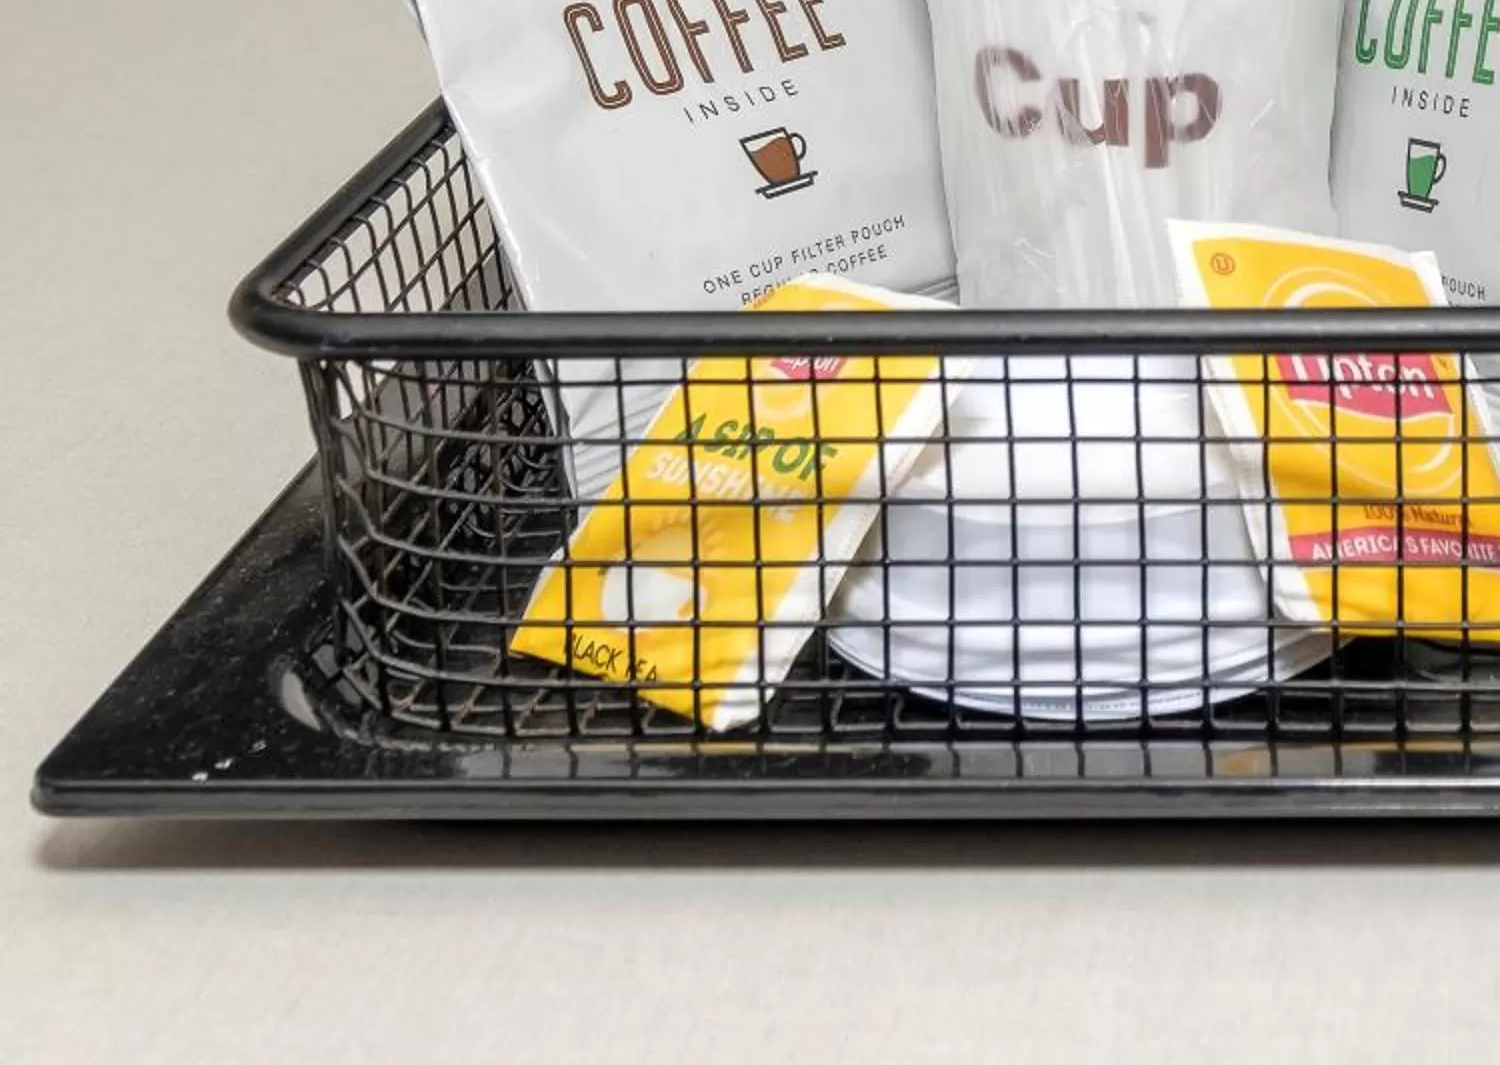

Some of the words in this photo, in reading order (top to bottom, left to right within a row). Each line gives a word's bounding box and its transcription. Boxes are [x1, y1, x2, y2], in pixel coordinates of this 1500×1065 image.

[683, 78, 799, 124] INSIDE
[974, 45, 1223, 169] Cup
[1391, 85, 1473, 119] INSIDE
[702, 269, 743, 295] ONE
[749, 255, 784, 279] CUP
[791, 233, 846, 264] FILTER
[850, 213, 905, 244] POUCH
[826, 243, 889, 276] COFFEE
[1441, 275, 1487, 302] POUCH
[771, 437, 839, 482] OF
[1364, 502, 1411, 521] 100
[566, 631, 622, 675] LACK
